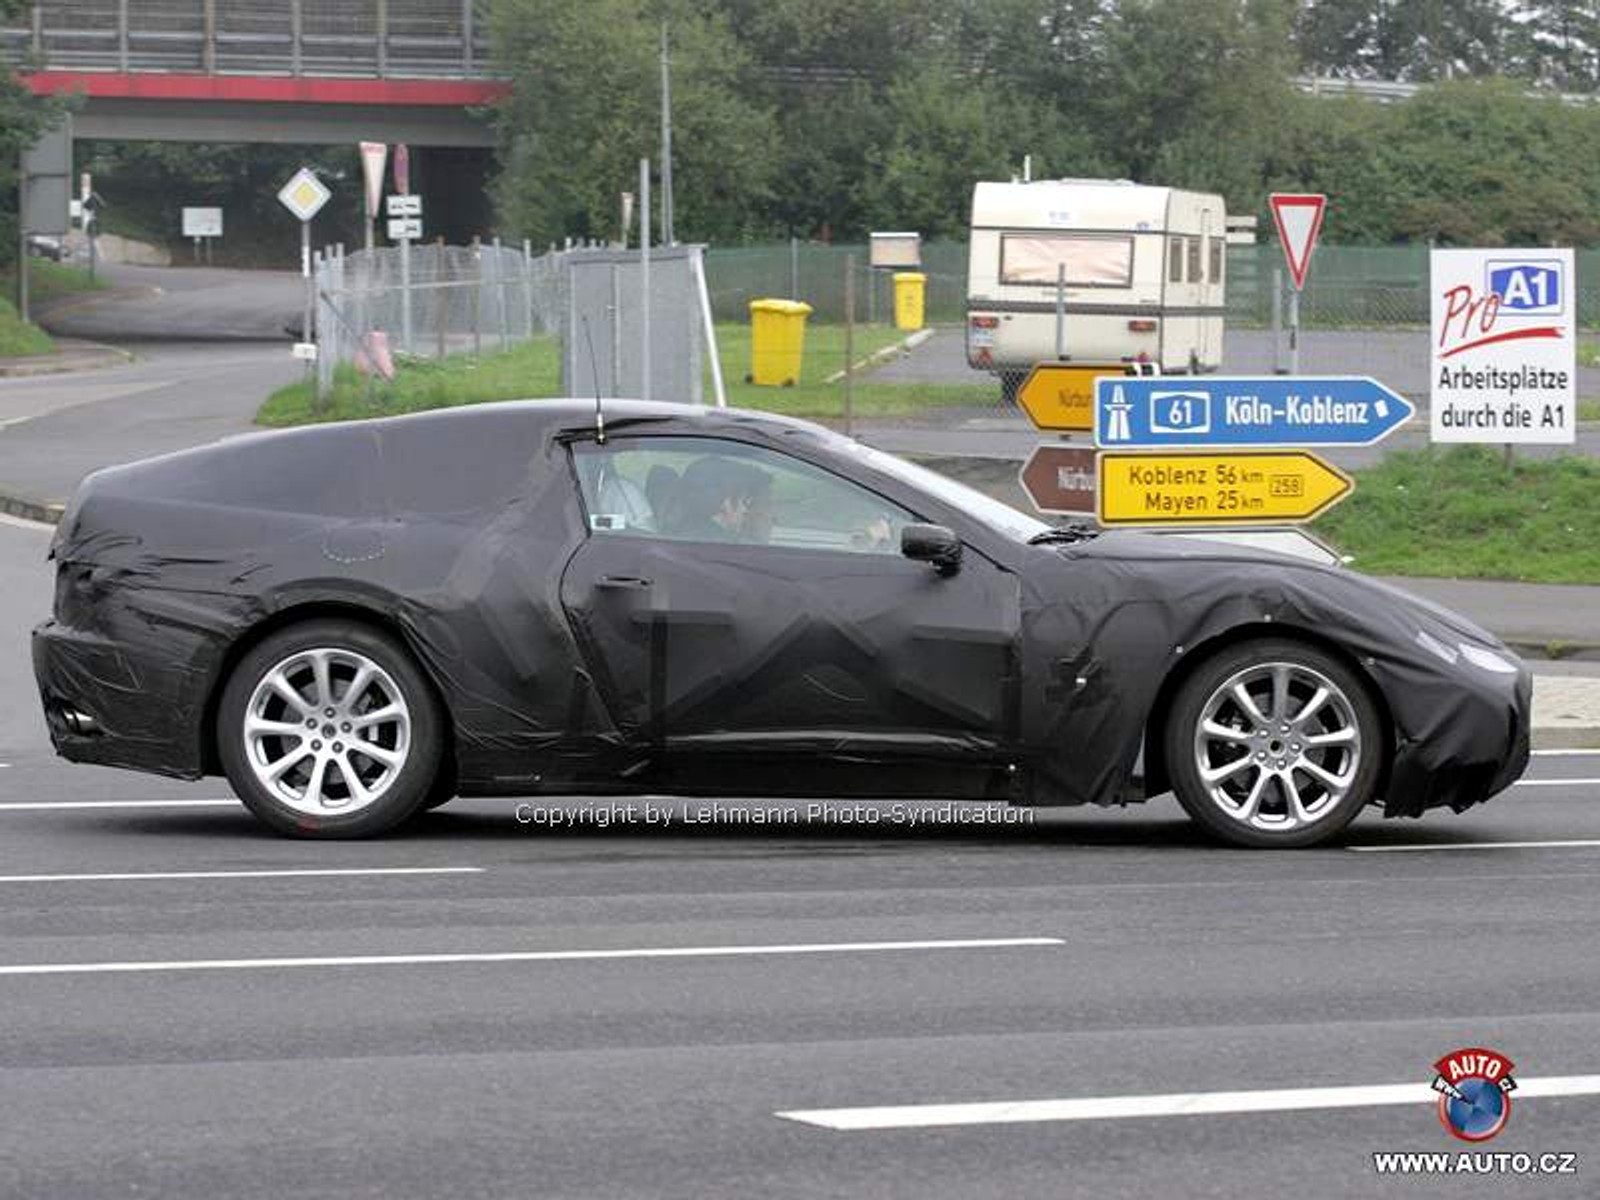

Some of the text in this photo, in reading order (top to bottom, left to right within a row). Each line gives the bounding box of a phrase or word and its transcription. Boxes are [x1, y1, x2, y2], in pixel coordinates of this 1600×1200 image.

[1440, 271, 1548, 347] Pro A1
[1439, 365, 1568, 395] Arbeitsplätze
[1169, 400, 1192, 424] 61
[1225, 396, 1369, 425] Köln-Koblenz
[1441, 404, 1565, 428] durch die A1
[1129, 464, 1264, 486] Koblenz 56 km
[1145, 490, 1264, 514] Mayen 25 km
